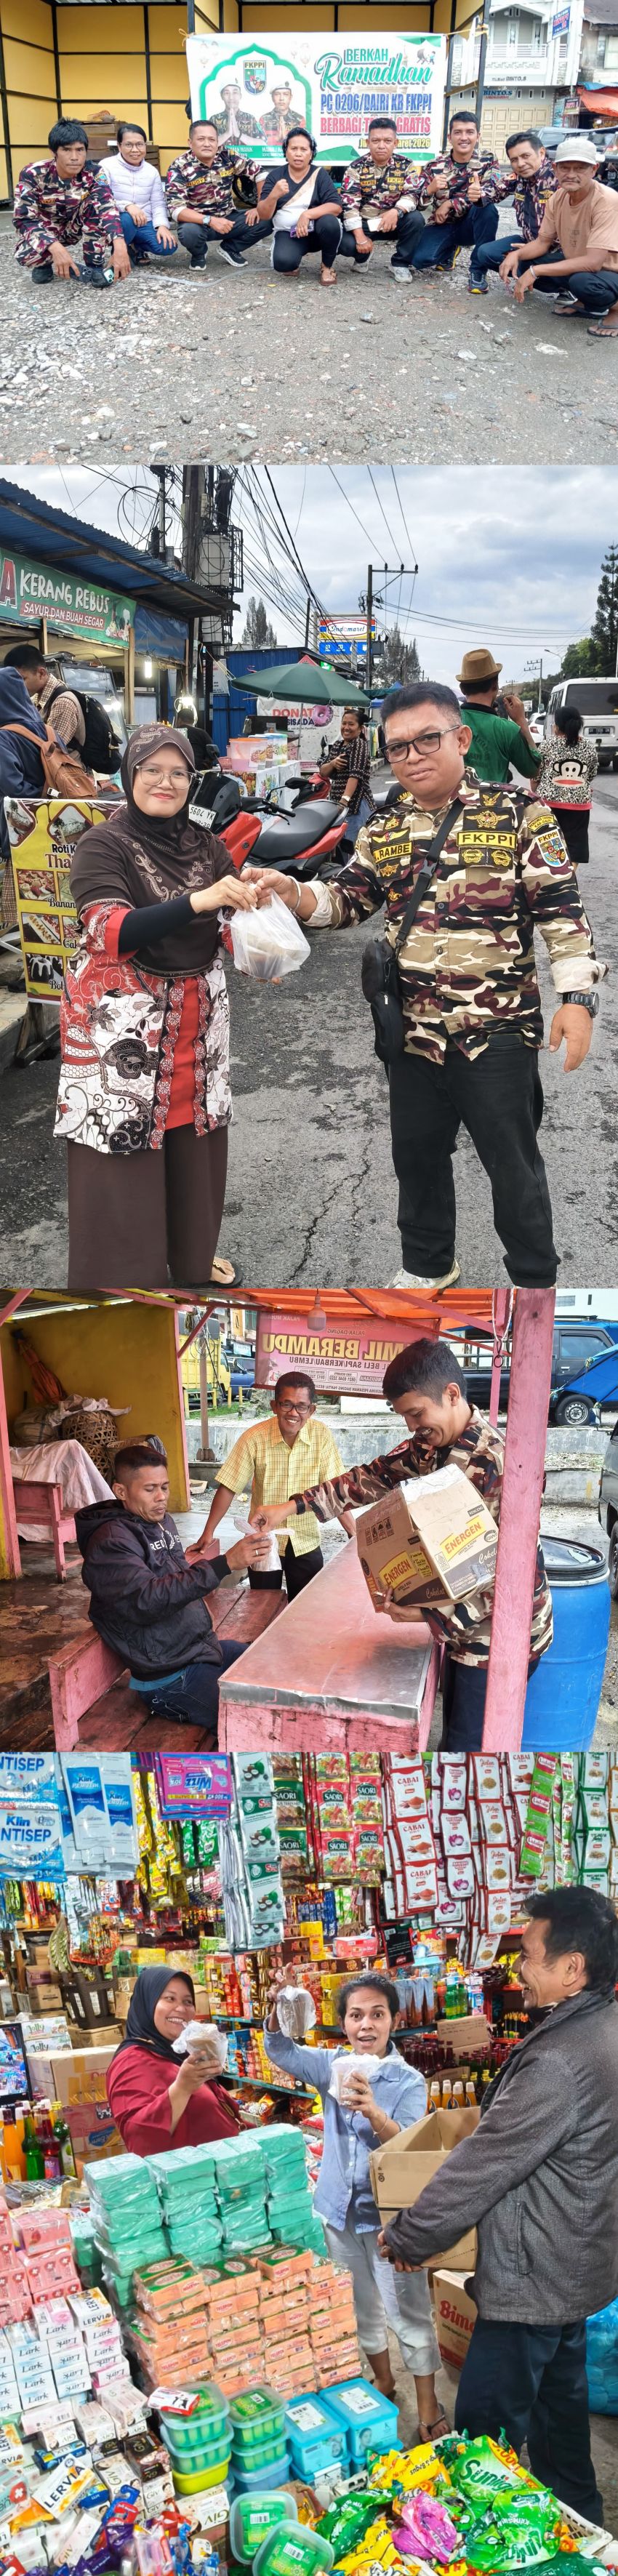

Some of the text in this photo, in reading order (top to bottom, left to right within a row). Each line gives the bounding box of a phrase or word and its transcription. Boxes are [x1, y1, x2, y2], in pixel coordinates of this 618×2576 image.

[345, 49, 388, 63] BERKAH
[315, 52, 433, 92] Ramadhan
[321, 93, 432, 114] PC 0206/DAIRI KB FKPPI
[320, 117, 361, 135] BERBAGI
[396, 116, 431, 135] GRATIS
[396, 138, 430, 148] aret 2026
[20, 569, 73, 606] KERANG
[76, 587, 110, 614] REBUS
[24, 602, 103, 628] SAYUR DAN BUAH SEGAR
[272, 708, 314, 718] DONAT
[462, 833, 513, 846] FKPPI
[538, 831, 558, 843] FKPPI
[52, 843, 69, 854] Roti
[445, 1522, 482, 1554] ENERGEN
[383, 1558, 412, 1586] ENERGEN
[397, 1776, 419, 1785] CABAI
[6, 1814, 30, 1826] Klin
[403, 1823, 425, 1832] CABAI
[26, 2023, 44, 2033] Jolly
[31, 2043, 49, 2052] Jolly
[84, 2314, 111, 2325] LERVIA
[46, 2324, 66, 2335] Lark
[93, 2328, 113, 2339] Lark
[20, 2347, 40, 2356] Lark
[95, 2346, 113, 2356] Lark
[23, 2362, 43, 2372] Lark
[25, 2378, 45, 2388] Lark
[28, 2393, 49, 2403] Lark
[1, 2454, 23, 2464] RVIA
[44, 2465, 86, 2508] LERVIA
